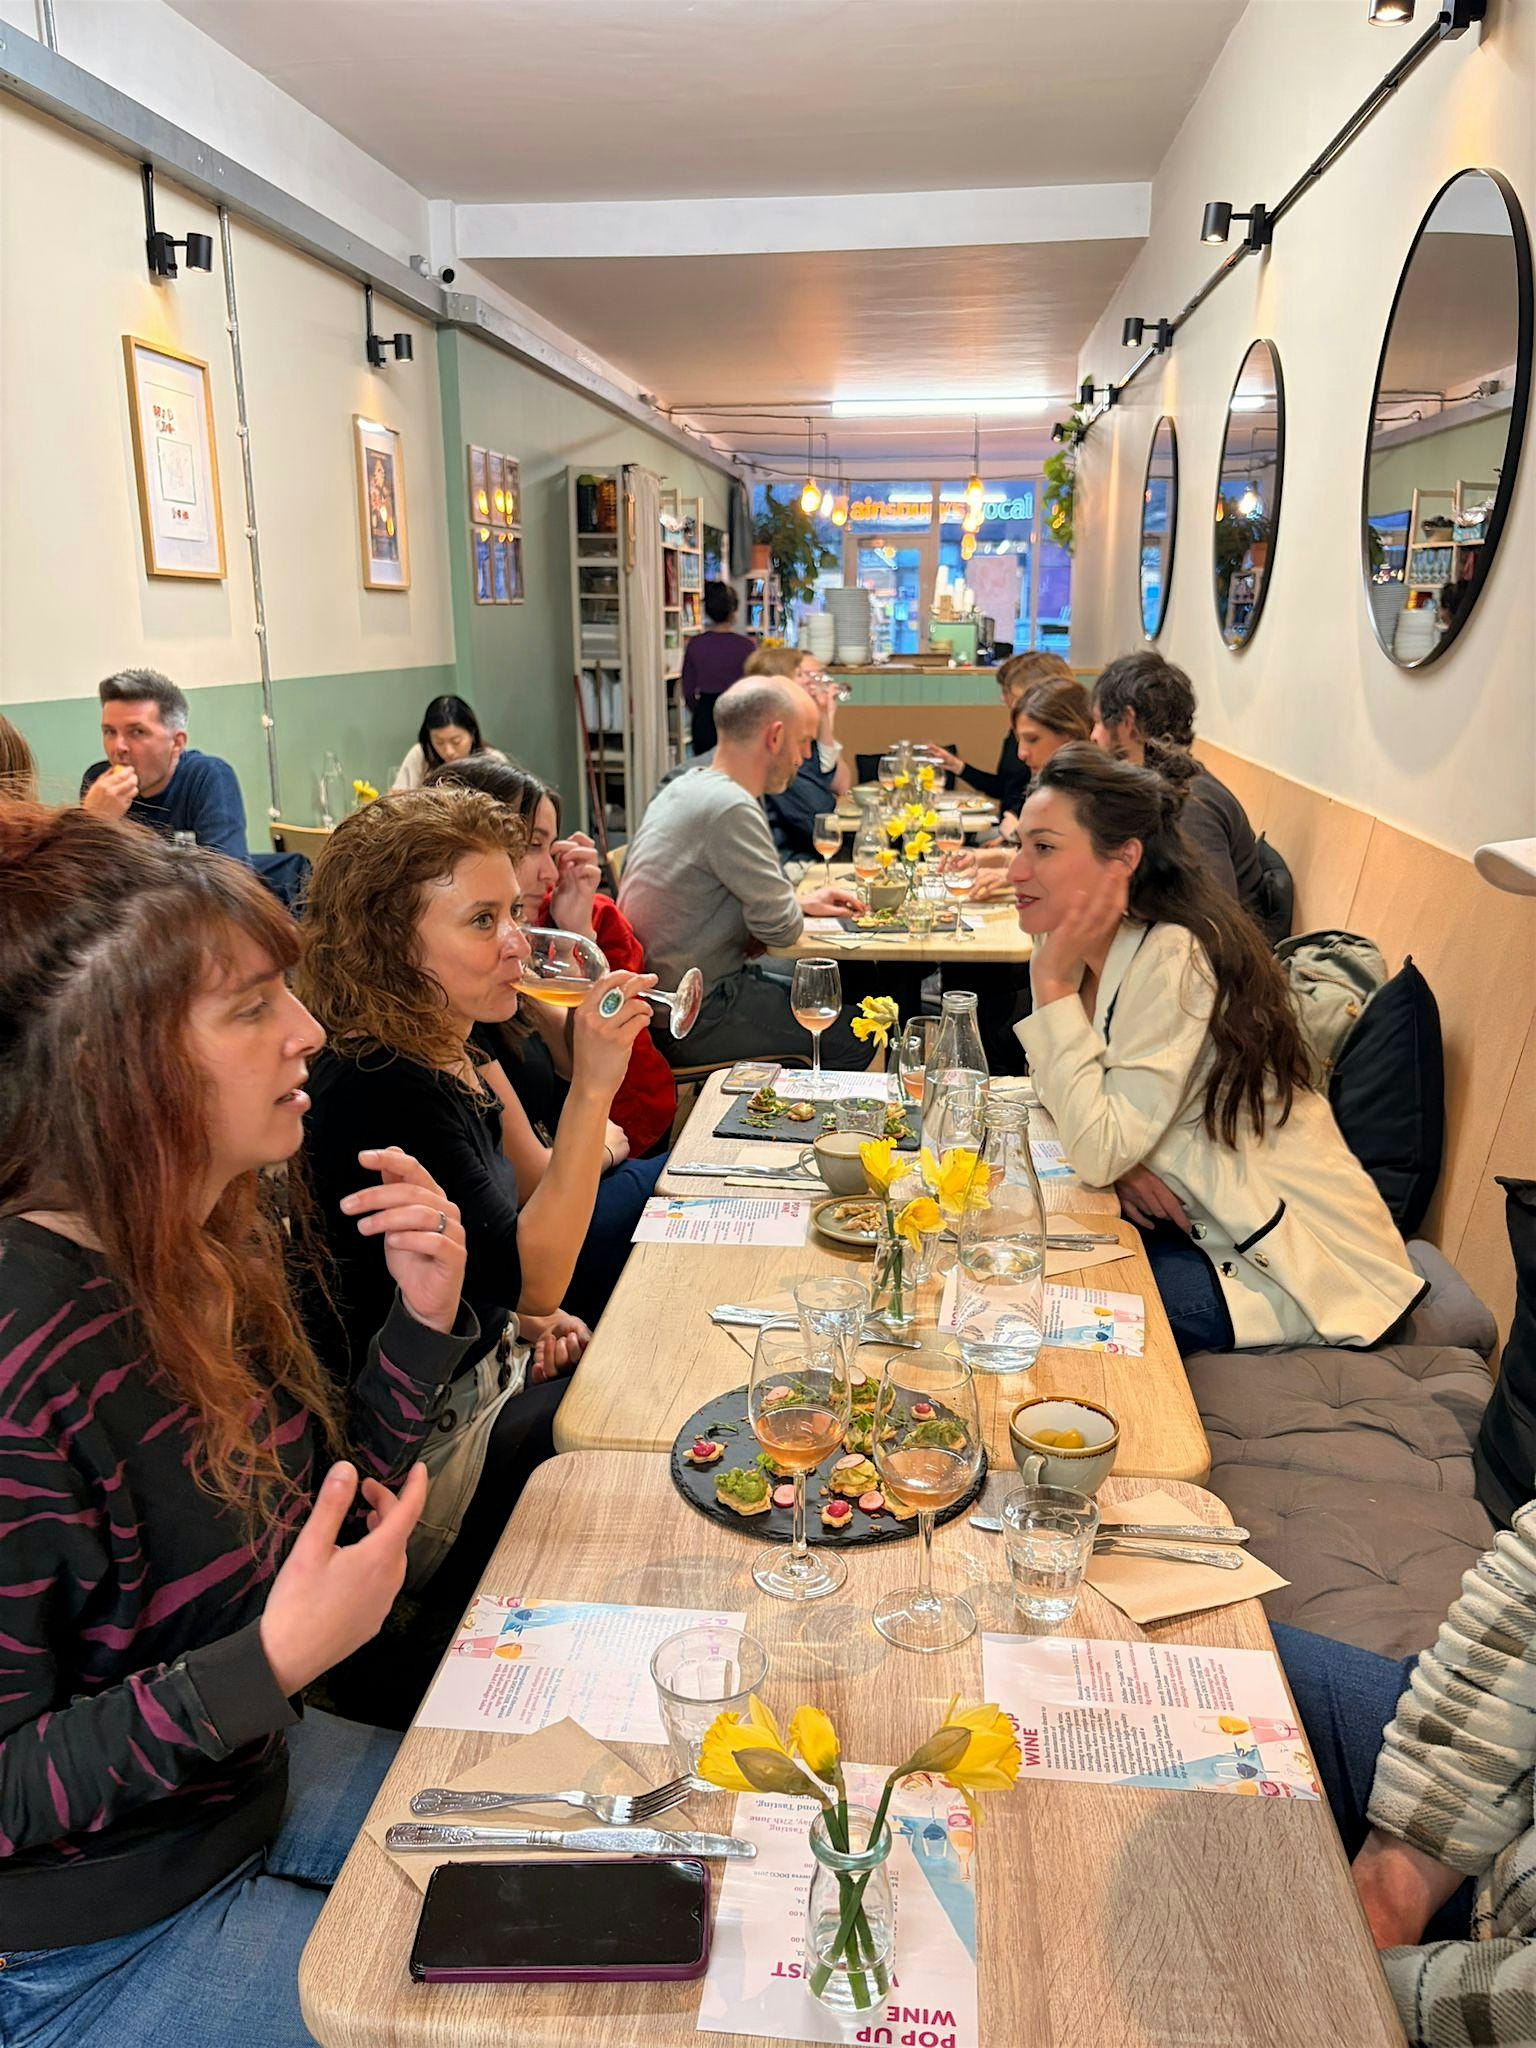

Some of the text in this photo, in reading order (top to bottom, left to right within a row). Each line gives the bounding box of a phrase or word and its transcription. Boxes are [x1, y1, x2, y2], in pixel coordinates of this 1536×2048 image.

[983, 492, 1033, 520] ocal
[1023, 1728, 1041, 1766] WINE
[797, 1804, 821, 1812] yond
[749, 1815, 771, 1824] June
[768, 1824, 803, 1834] Tasting
[886, 2006, 957, 2027] WINE
[856, 2026, 955, 2048] POP UP
